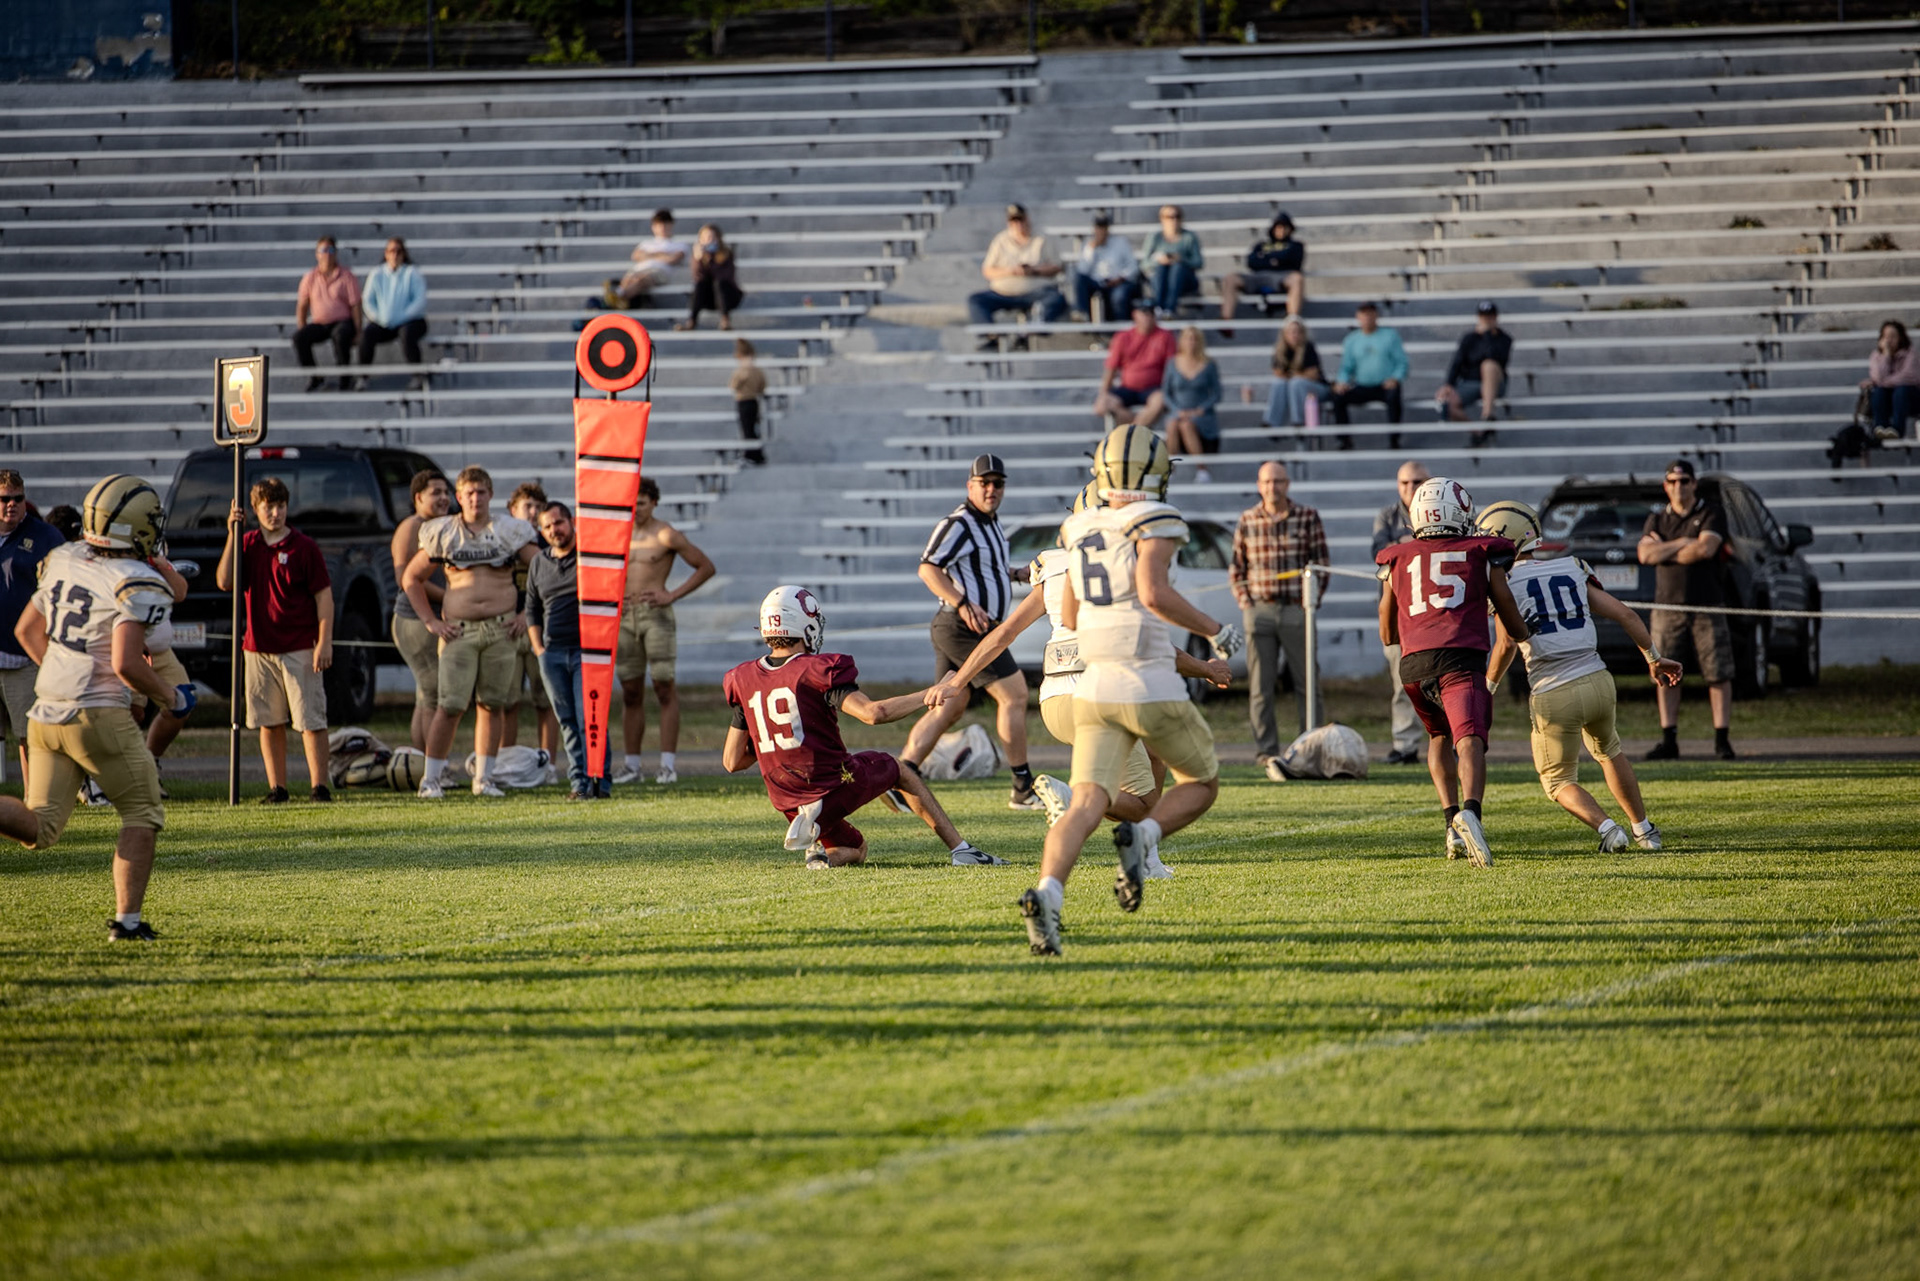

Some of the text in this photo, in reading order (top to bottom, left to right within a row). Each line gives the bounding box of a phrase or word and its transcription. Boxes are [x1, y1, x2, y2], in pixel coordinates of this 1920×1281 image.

[229, 367, 255, 428] 3
[1425, 509, 1441, 523] 15
[1077, 532, 1113, 606] 6
[1407, 551, 1467, 616] 15
[47, 580, 93, 653] 12
[145, 604, 166, 625] 12
[768, 614, 781, 627] 19
[1526, 574, 1586, 636] 10
[589, 689, 599, 749] Gilman
[748, 687, 805, 753] 19
